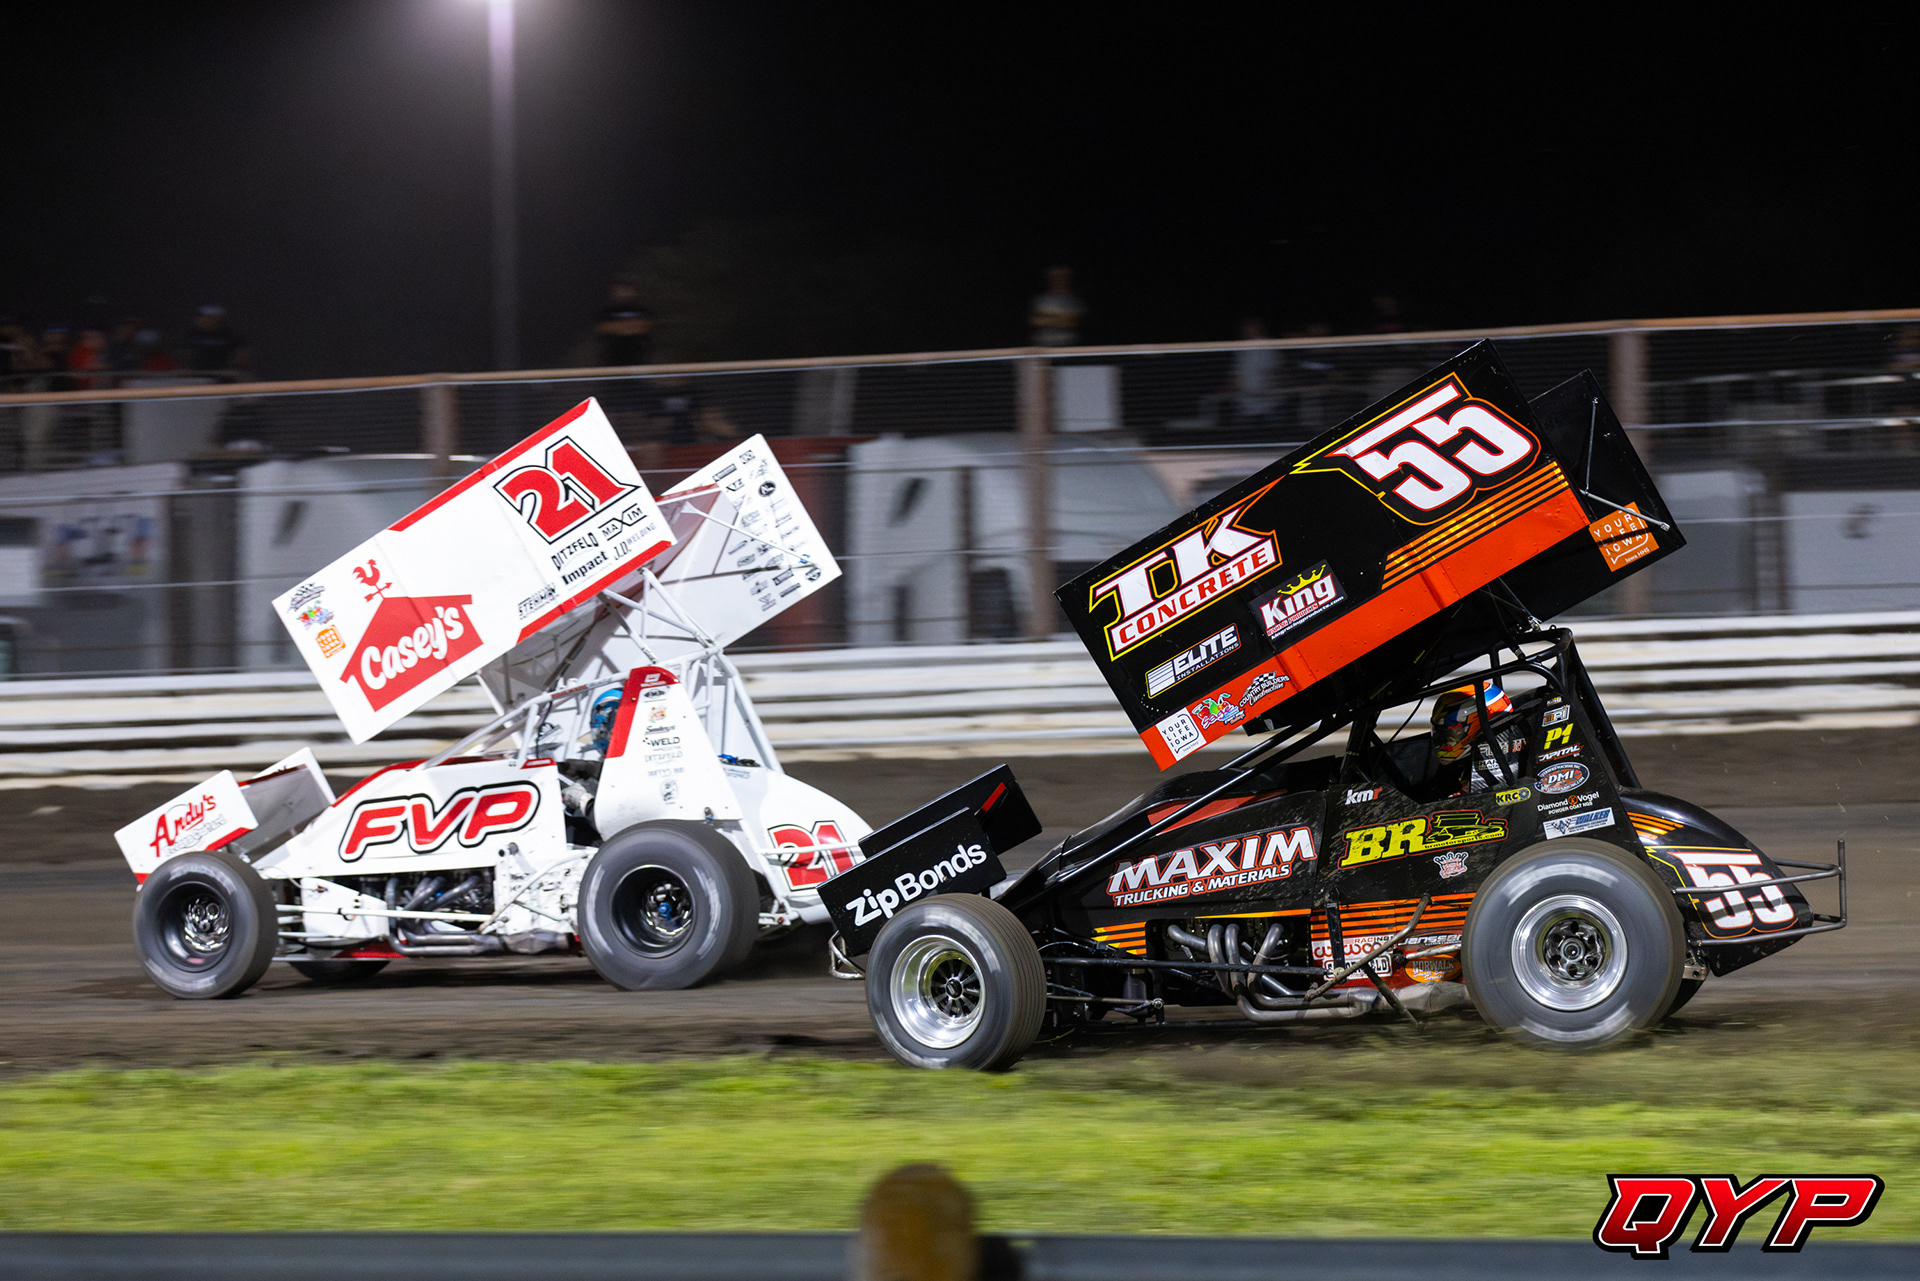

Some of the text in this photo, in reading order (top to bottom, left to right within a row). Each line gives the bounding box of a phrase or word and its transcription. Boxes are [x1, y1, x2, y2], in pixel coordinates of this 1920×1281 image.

[1325, 382, 1534, 512] 55
[495, 437, 640, 544] 21
[599, 503, 648, 540] MAXIM
[1593, 513, 1633, 538] YOUR
[551, 532, 599, 571] DITZFELD
[1095, 504, 1266, 620] TK
[1605, 534, 1643, 556] IOWA
[562, 550, 608, 585] Impact
[1118, 549, 1269, 645] CONCRETE
[1259, 572, 1338, 630] King
[361, 605, 465, 690] Casey's
[1173, 625, 1238, 676] ELITE
[1176, 643, 1239, 681] INSTALLATIONS
[1239, 675, 1290, 708] COUNTRY BUILDERS
[1162, 718, 1187, 736] YOUR
[1166, 725, 1190, 742] LIFE
[1201, 705, 1233, 729] Sage
[650, 737, 681, 746] WELD
[1170, 731, 1194, 748] IOWA
[1538, 745, 1581, 761] CAPITAL
[1544, 723, 1573, 749] P1
[1548, 770, 1574, 784] DMI
[1344, 787, 1383, 805] kmr
[1496, 790, 1520, 805] KRC
[1537, 791, 1600, 811] Diamond Vogel
[1548, 801, 1593, 814] POWDER COATNGS
[150, 794, 216, 857] Andy's
[342, 784, 538, 861] FVP
[1575, 809, 1611, 825] WALKER
[768, 820, 856, 892] 21
[1341, 818, 1429, 867] BR
[1424, 832, 1503, 849] brmotorsports.com
[1109, 828, 1315, 894] MAXIM
[1115, 864, 1291, 907] TRUCKING & MATERIALS
[1667, 851, 1795, 930] 55
[1412, 960, 1455, 974] NORWALK
